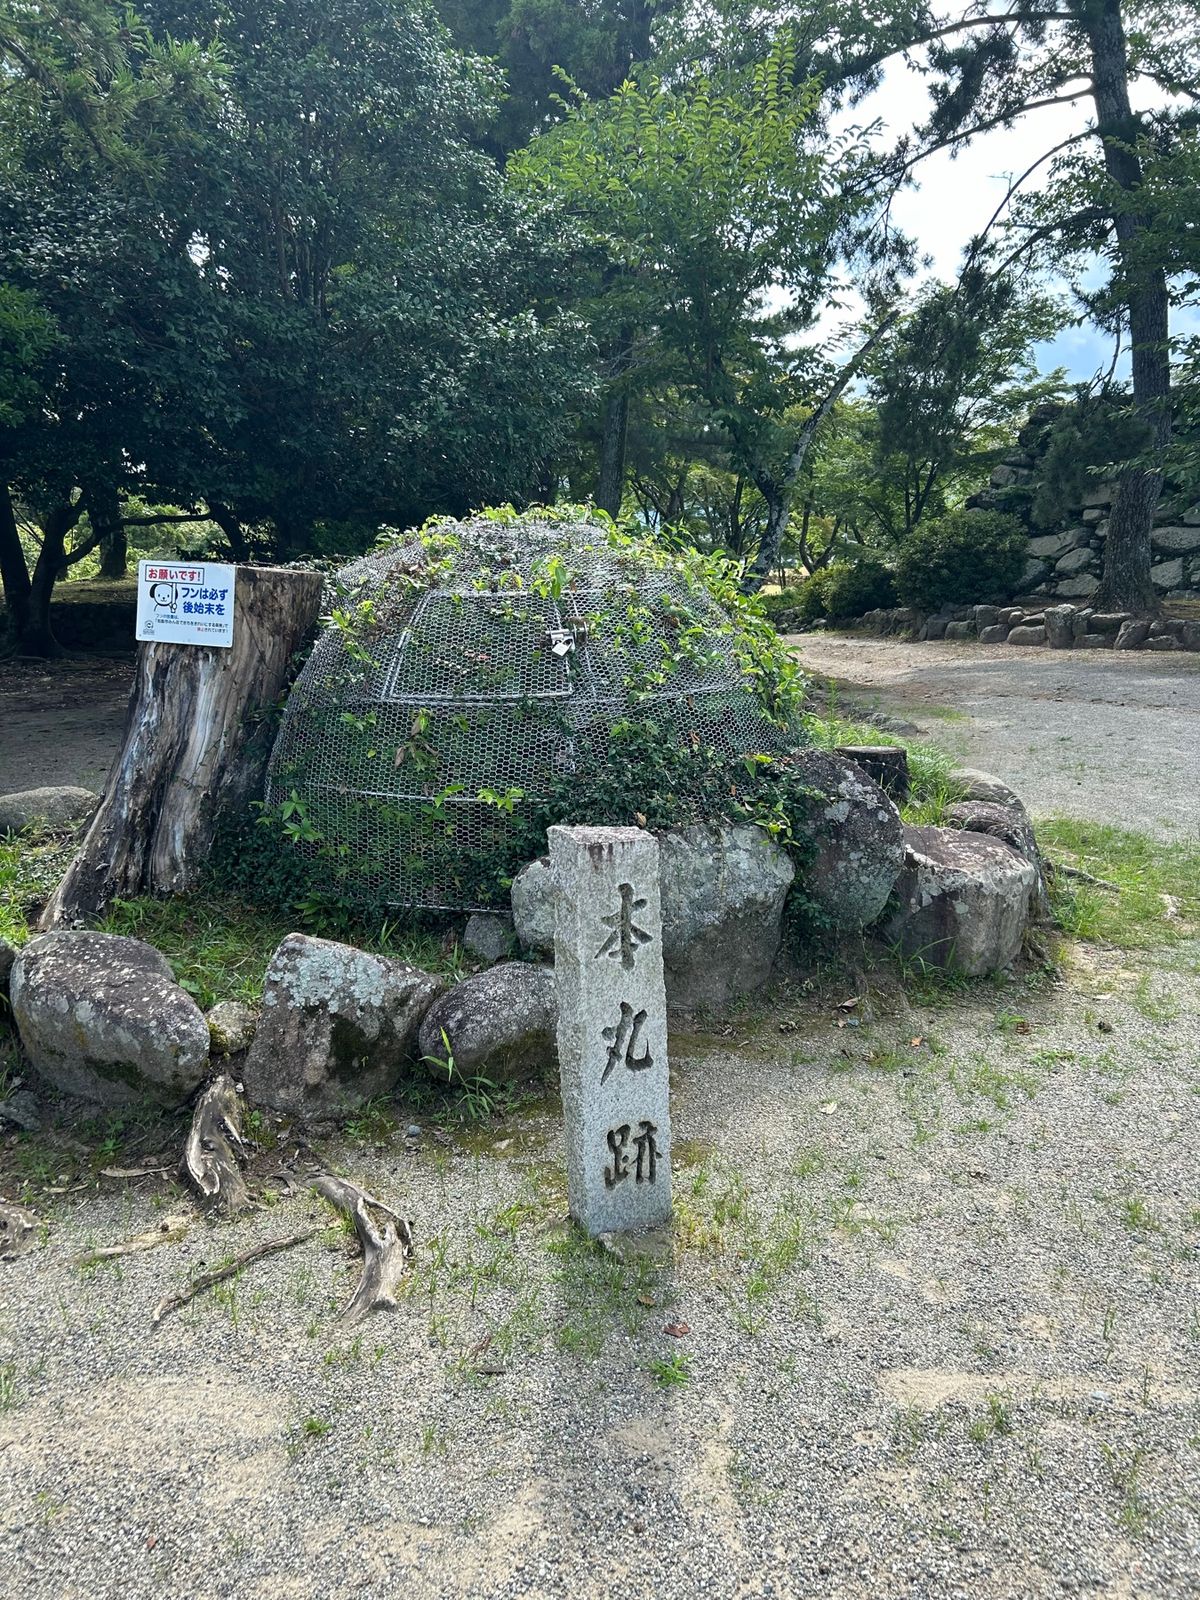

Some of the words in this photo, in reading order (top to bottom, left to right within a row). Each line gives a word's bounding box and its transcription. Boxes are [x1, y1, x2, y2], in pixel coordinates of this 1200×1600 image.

[148, 568, 201, 581] お願いです!
[181, 587, 229, 601] フンは必ず
[183, 601, 225, 615] 後始末を
[594, 882, 662, 1190] 本丸跡
